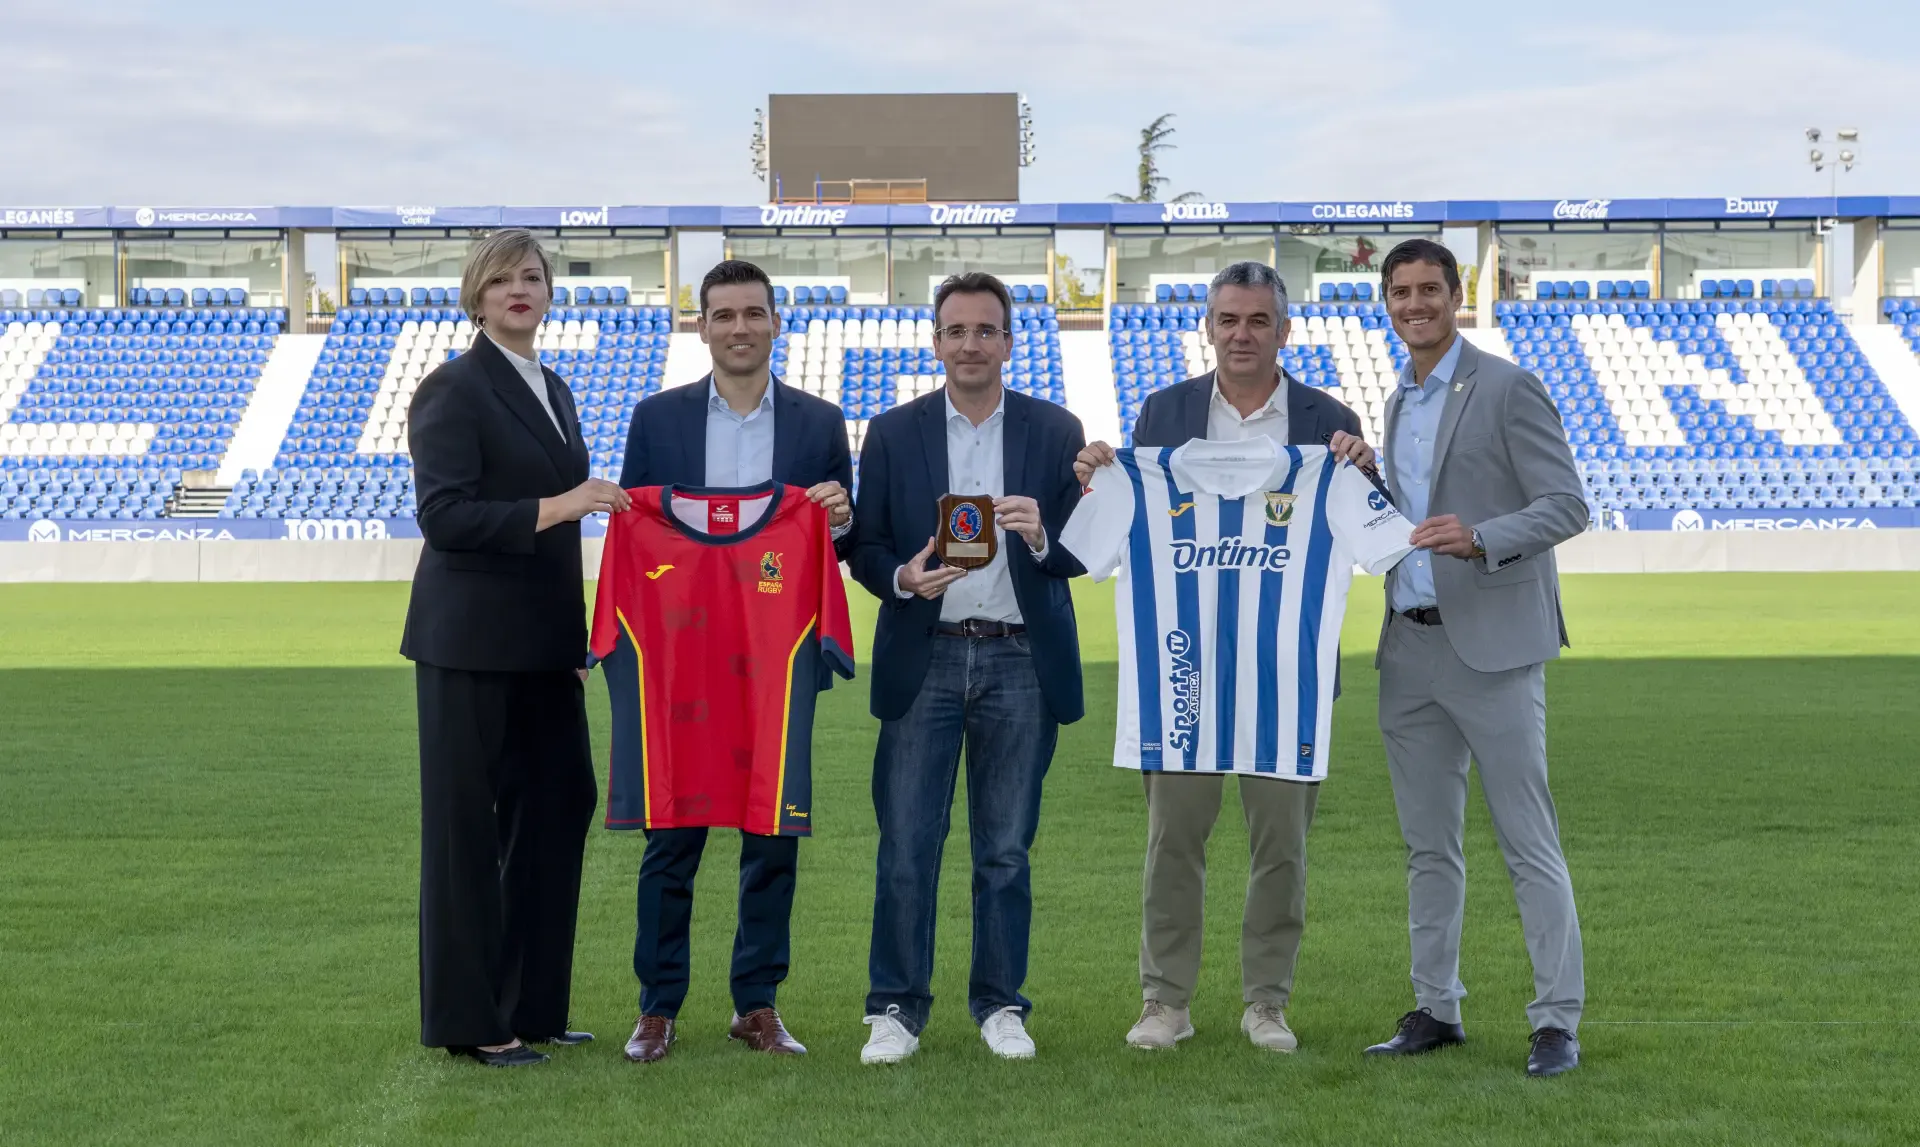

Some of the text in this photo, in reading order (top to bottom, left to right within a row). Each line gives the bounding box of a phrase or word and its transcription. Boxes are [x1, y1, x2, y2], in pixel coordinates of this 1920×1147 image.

[759, 204, 848, 226] Ontime
[930, 204, 1018, 226] Ontime
[1725, 198, 1778, 217] Ebury
[159, 213, 257, 222] MERCANZA
[1711, 517, 1877, 530] MERCANZA
[68, 527, 236, 541] MERCANZA
[1169, 536, 1291, 570] Ontime
[758, 586, 781, 594] RUGBY
[1190, 672, 1199, 712] AFRICA
